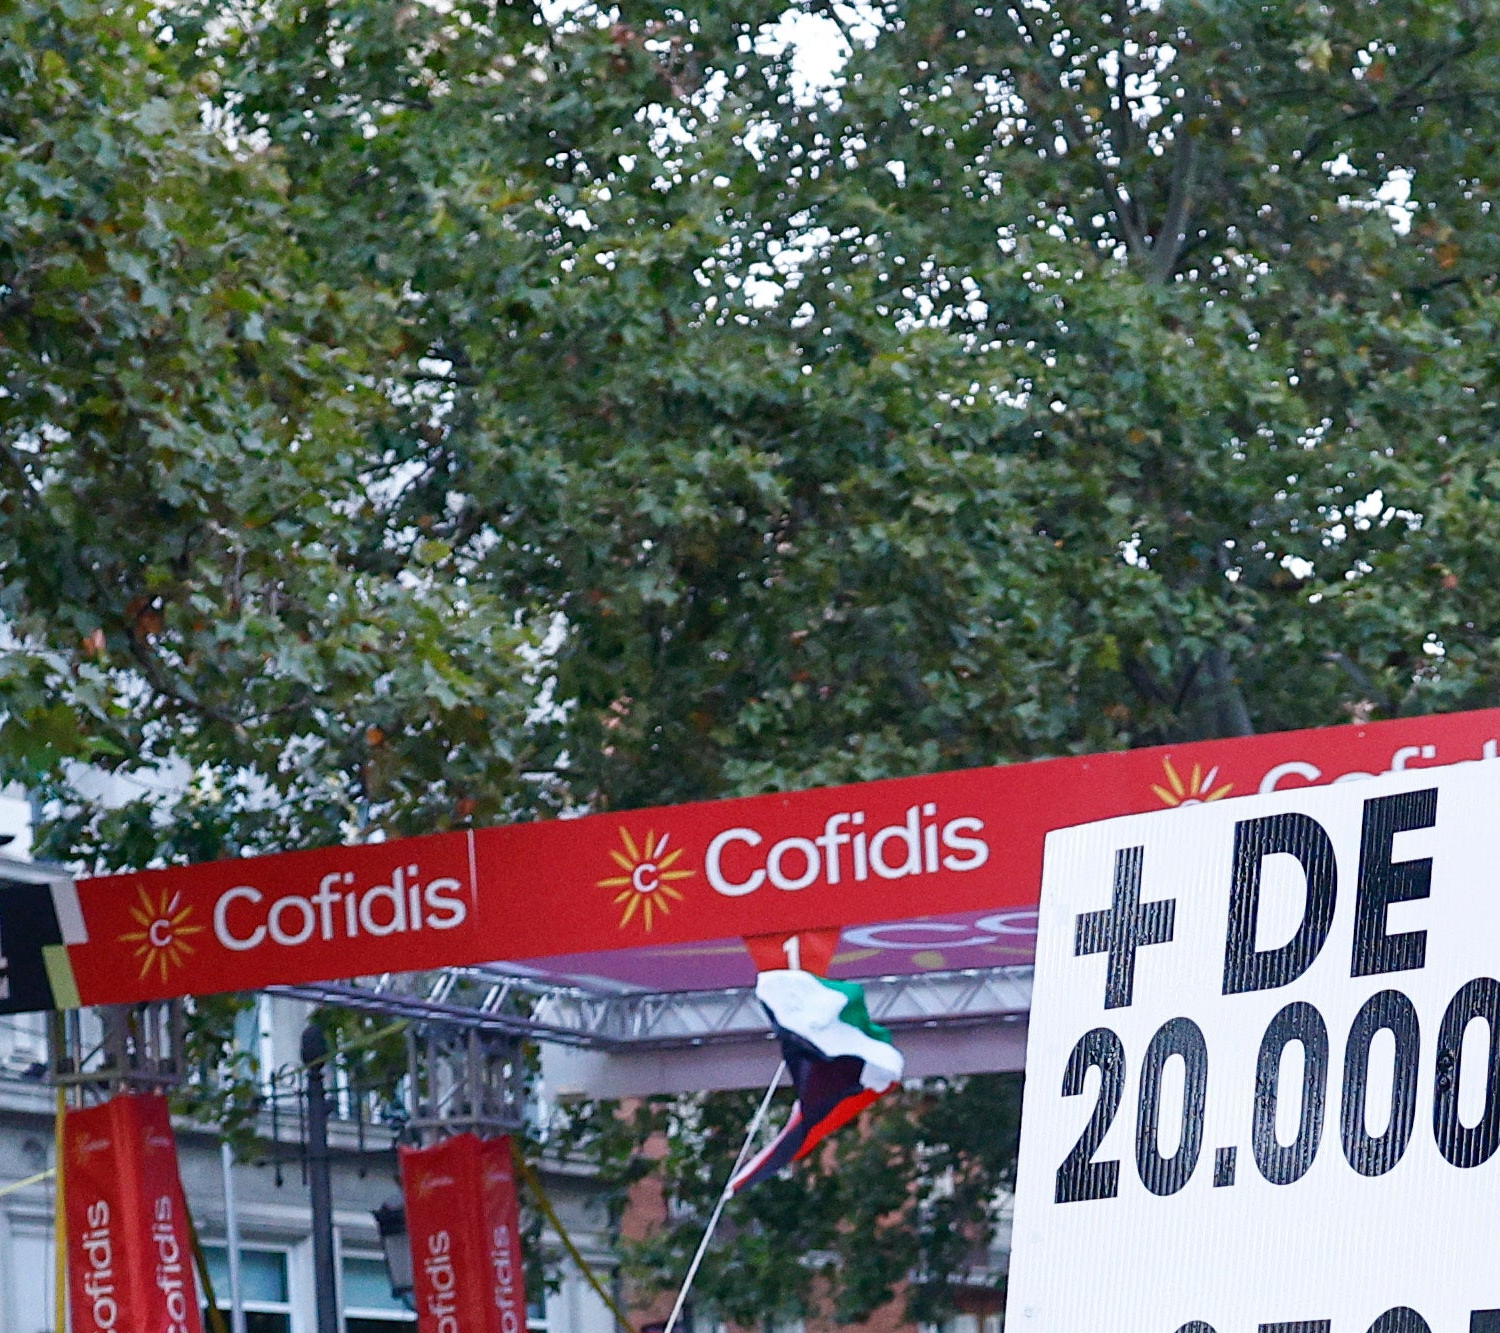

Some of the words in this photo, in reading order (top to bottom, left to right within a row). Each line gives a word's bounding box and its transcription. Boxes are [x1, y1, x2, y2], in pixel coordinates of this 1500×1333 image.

[704, 802, 989, 897] Cofidis
[1221, 787, 1439, 996] DE
[213, 864, 467, 951] Cofidis
